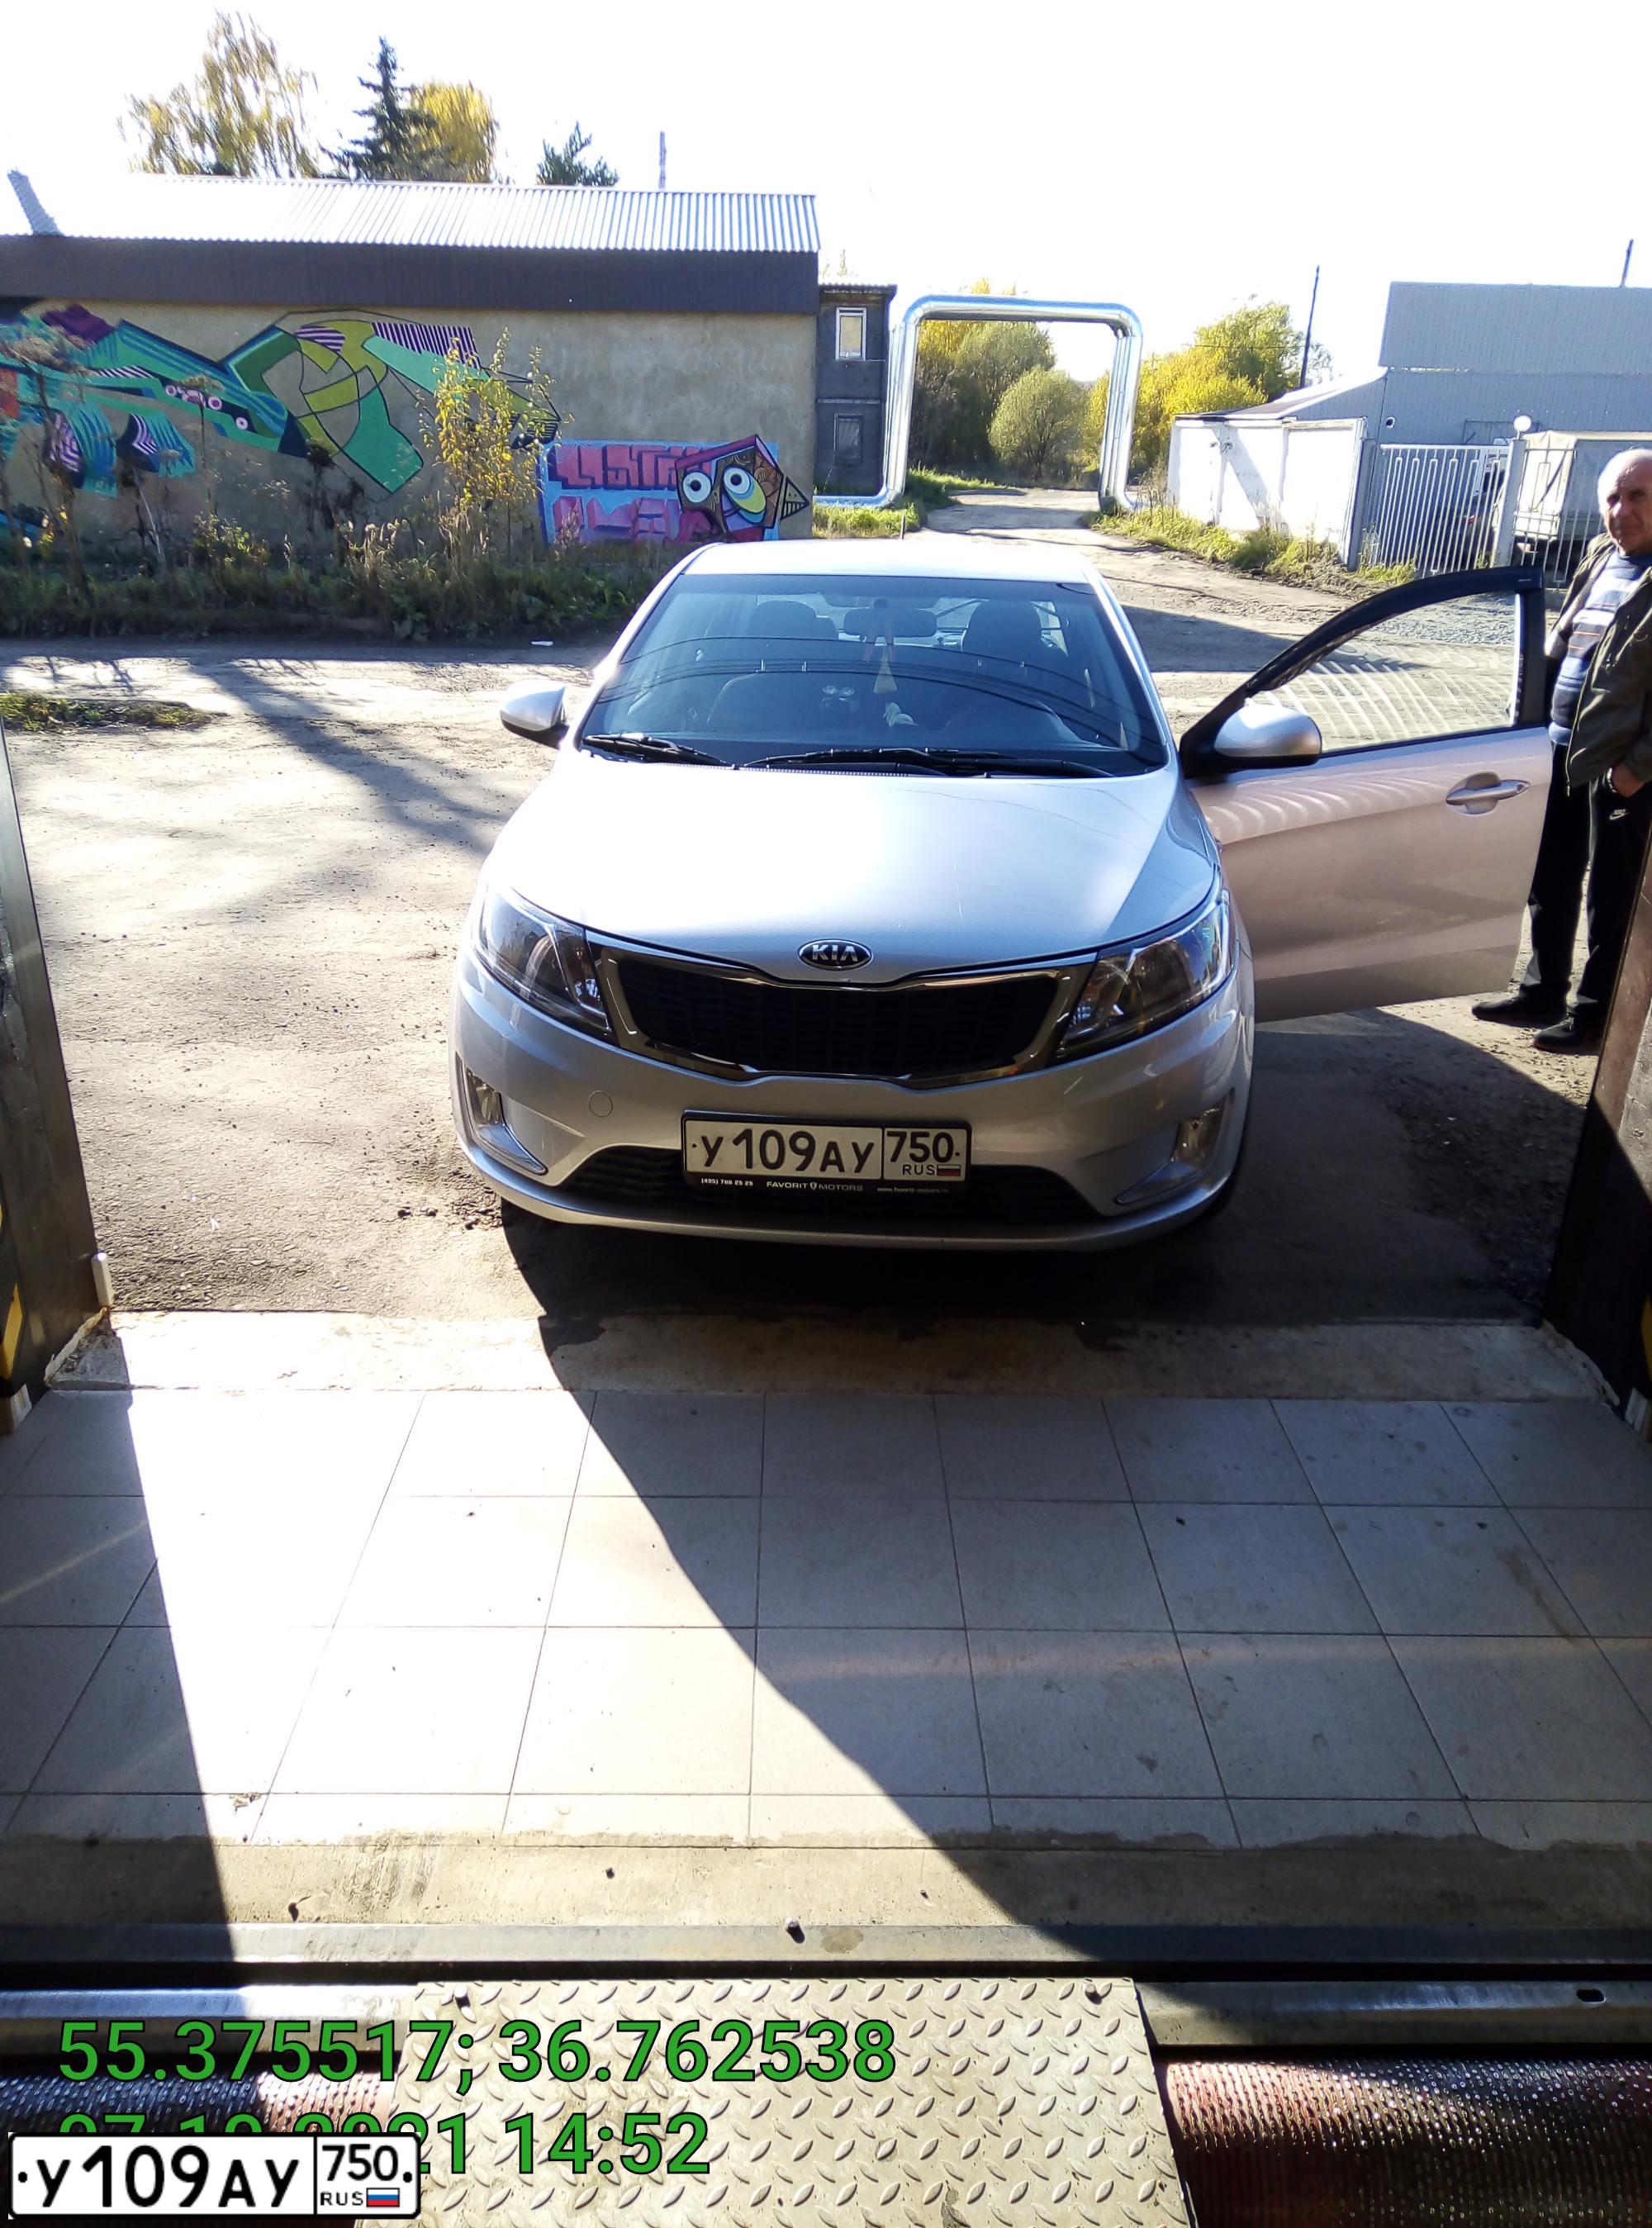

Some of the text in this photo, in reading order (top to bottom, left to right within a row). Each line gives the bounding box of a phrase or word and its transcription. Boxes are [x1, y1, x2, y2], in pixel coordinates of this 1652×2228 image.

[811, 944, 859, 962] KIA
[700, 1128, 952, 1173] У109АУ 750
[902, 1164, 936, 1176] RUS
[766, 1181, 864, 1191] FAVORIT MOTORS
